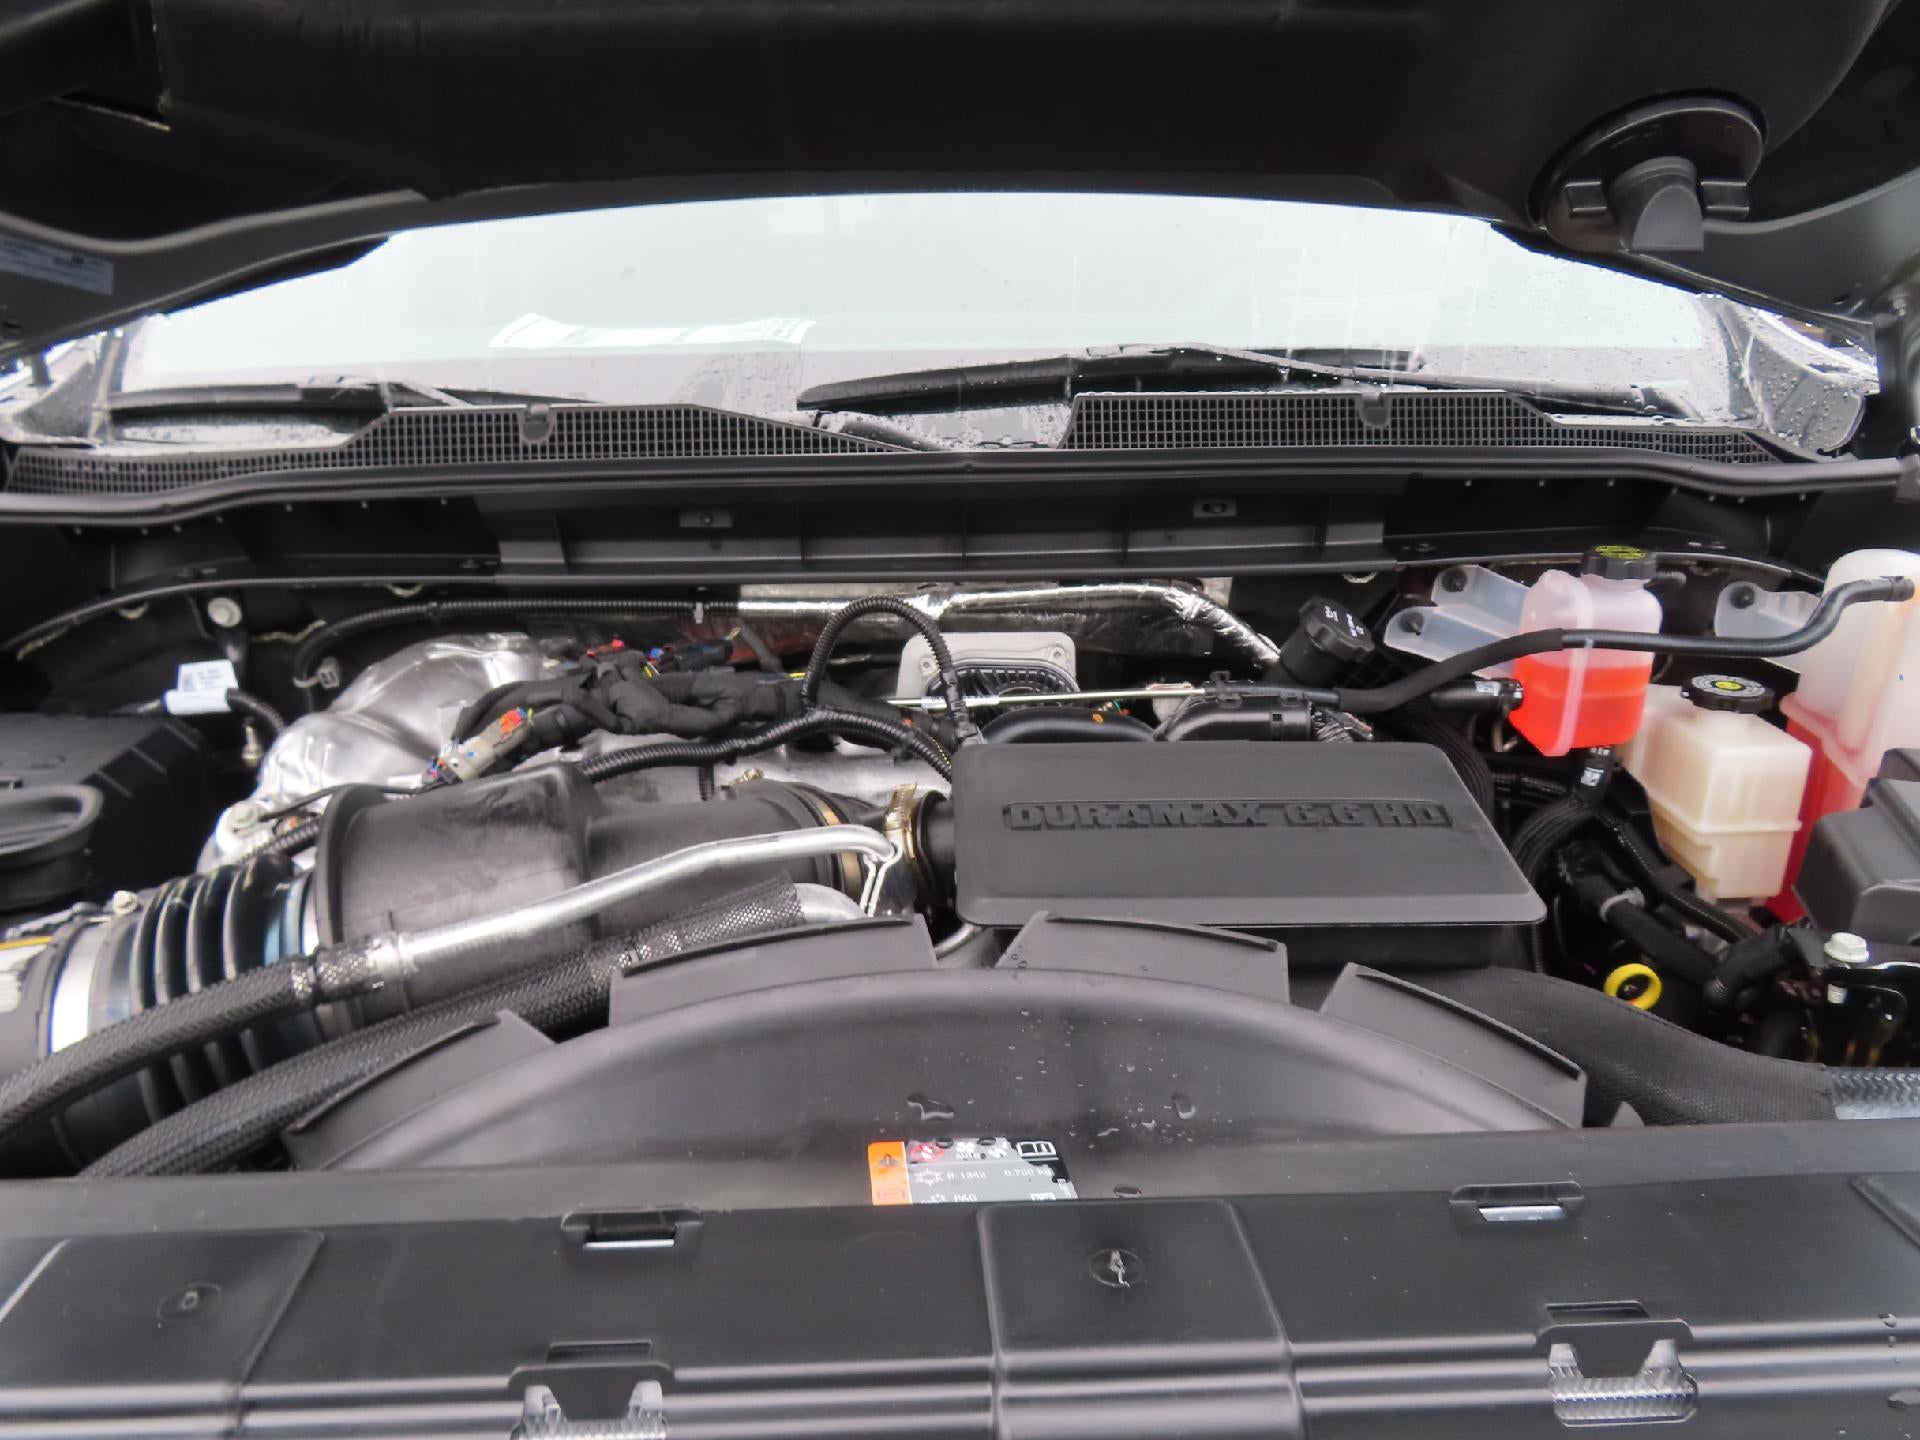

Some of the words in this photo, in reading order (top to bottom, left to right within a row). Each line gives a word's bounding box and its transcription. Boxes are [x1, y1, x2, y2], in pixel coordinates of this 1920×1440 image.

[1007, 803, 1264, 831] DURAMAX
[1285, 803, 1364, 828] 6.6
[1374, 803, 1451, 828] HD
